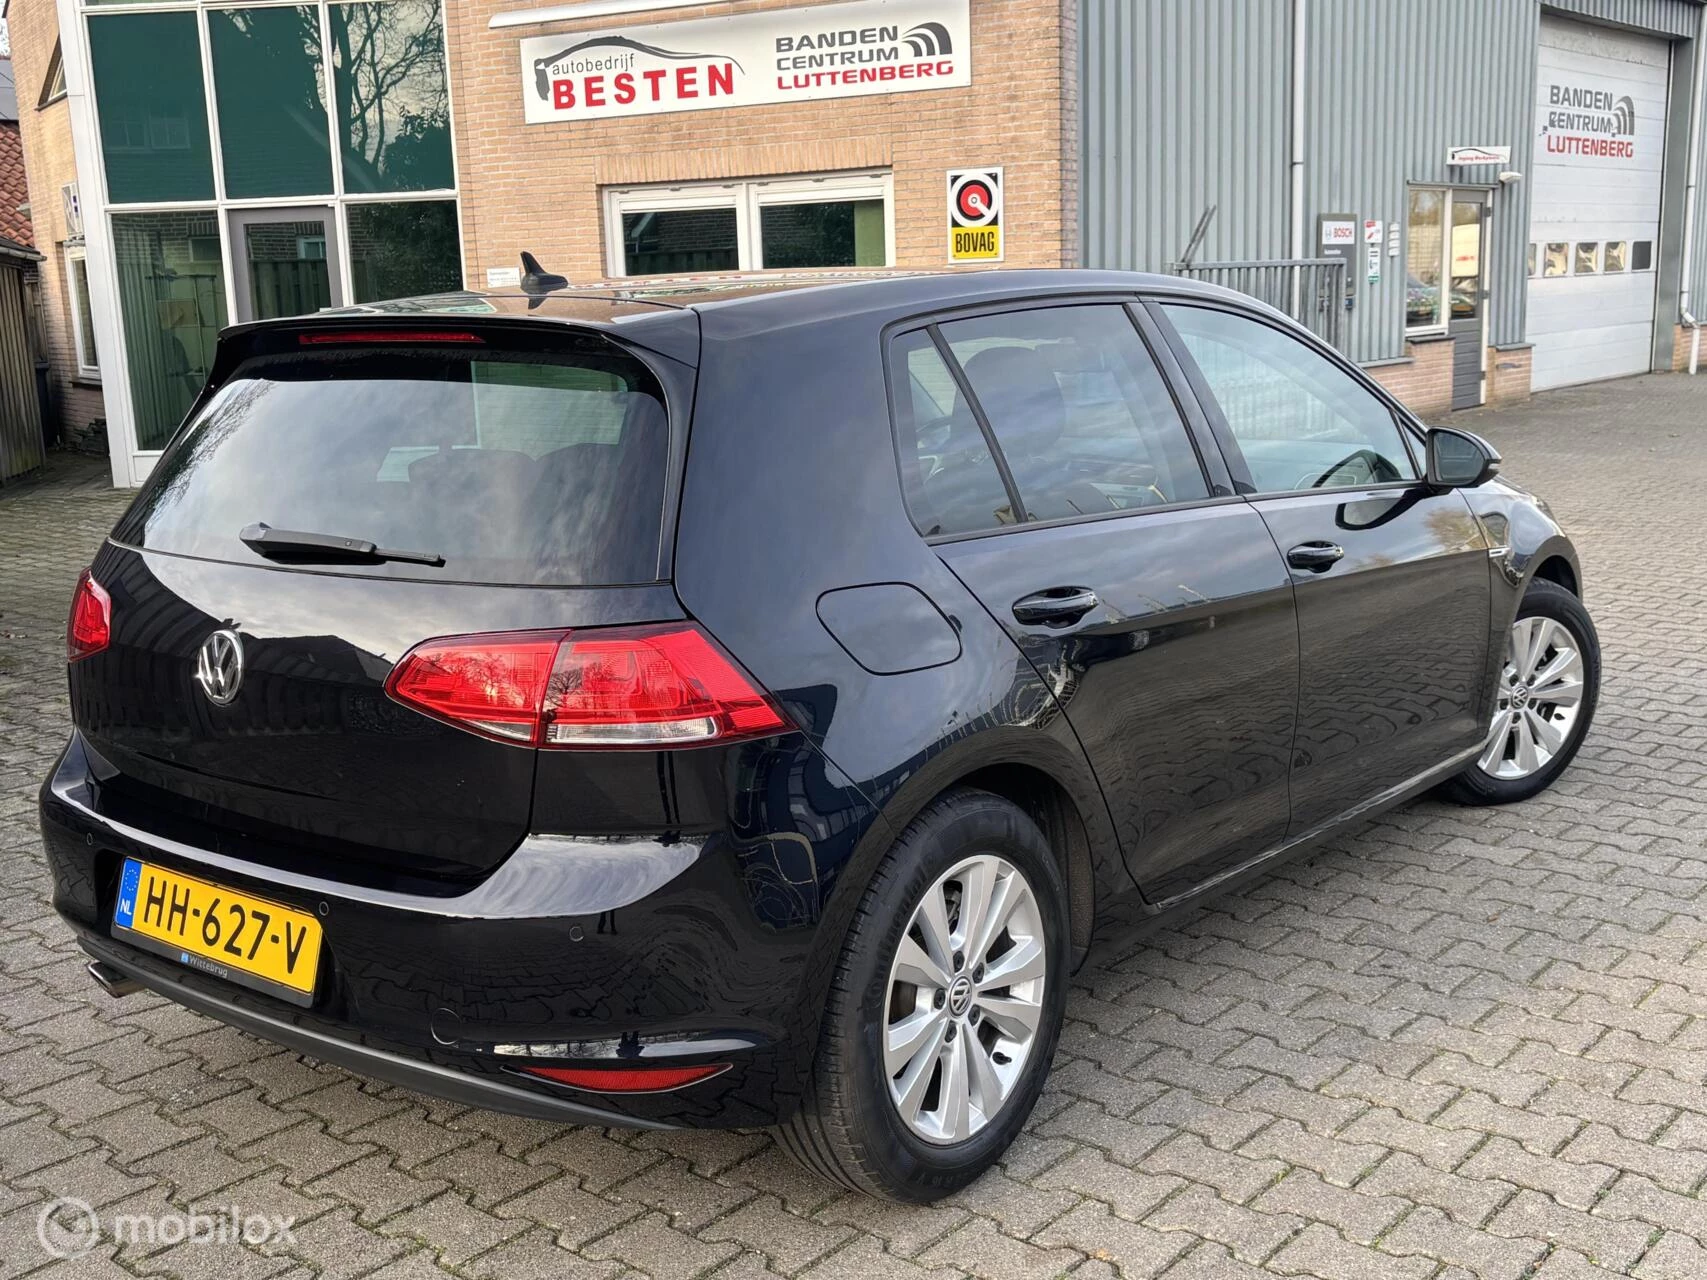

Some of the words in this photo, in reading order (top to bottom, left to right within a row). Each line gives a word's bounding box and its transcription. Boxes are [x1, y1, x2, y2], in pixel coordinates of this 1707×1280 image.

[776, 26, 898, 53] BANDEN
[552, 53, 635, 76] autobedrijf
[777, 47, 899, 71] CENTRUM
[553, 63, 734, 110] BESTEN
[777, 60, 954, 90] LUTTENBERG
[1550, 84, 1613, 112] BANDEN
[1548, 111, 1613, 133] CENTRUM
[1547, 135, 1633, 158] LUTTENBERG
[955, 231, 995, 253] BOVAG
[120, 898, 132, 916] NL
[143, 876, 307, 974] HH-627-V
[189, 954, 228, 977] Wittebrug
